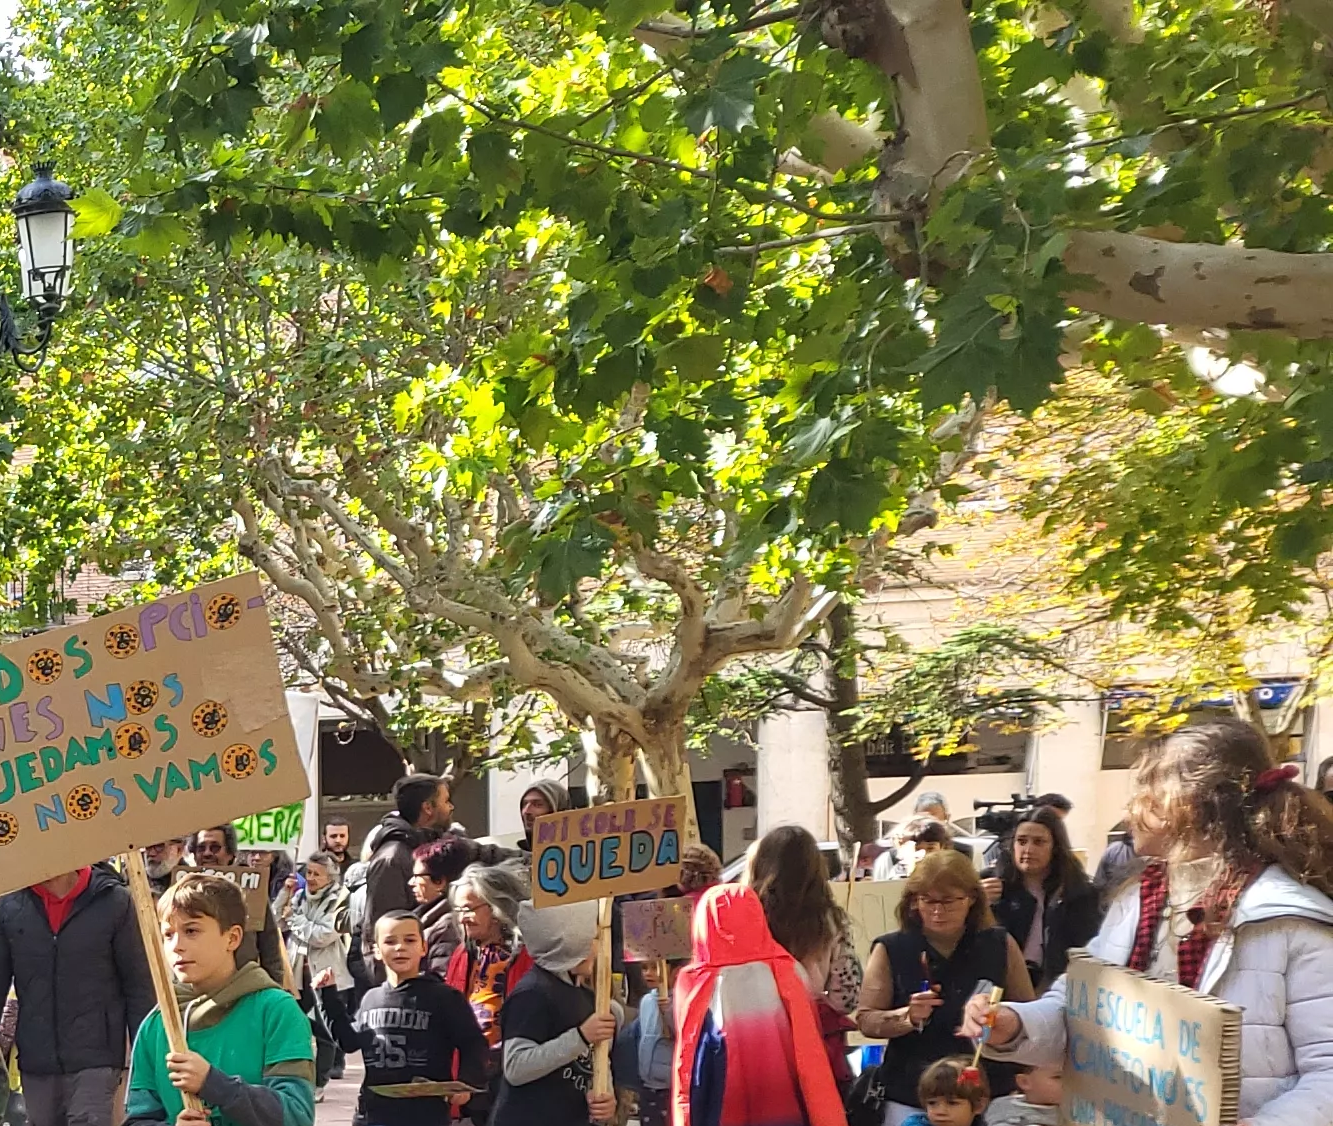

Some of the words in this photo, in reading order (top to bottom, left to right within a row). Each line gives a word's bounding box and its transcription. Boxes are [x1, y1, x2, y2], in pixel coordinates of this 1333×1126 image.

[84, 672, 184, 728] NOS
[35, 777, 127, 832] NOS
[134, 738, 278, 804] VAMOS
[538, 829, 680, 897] QUEDA
[372, 1033, 407, 1068] 35
